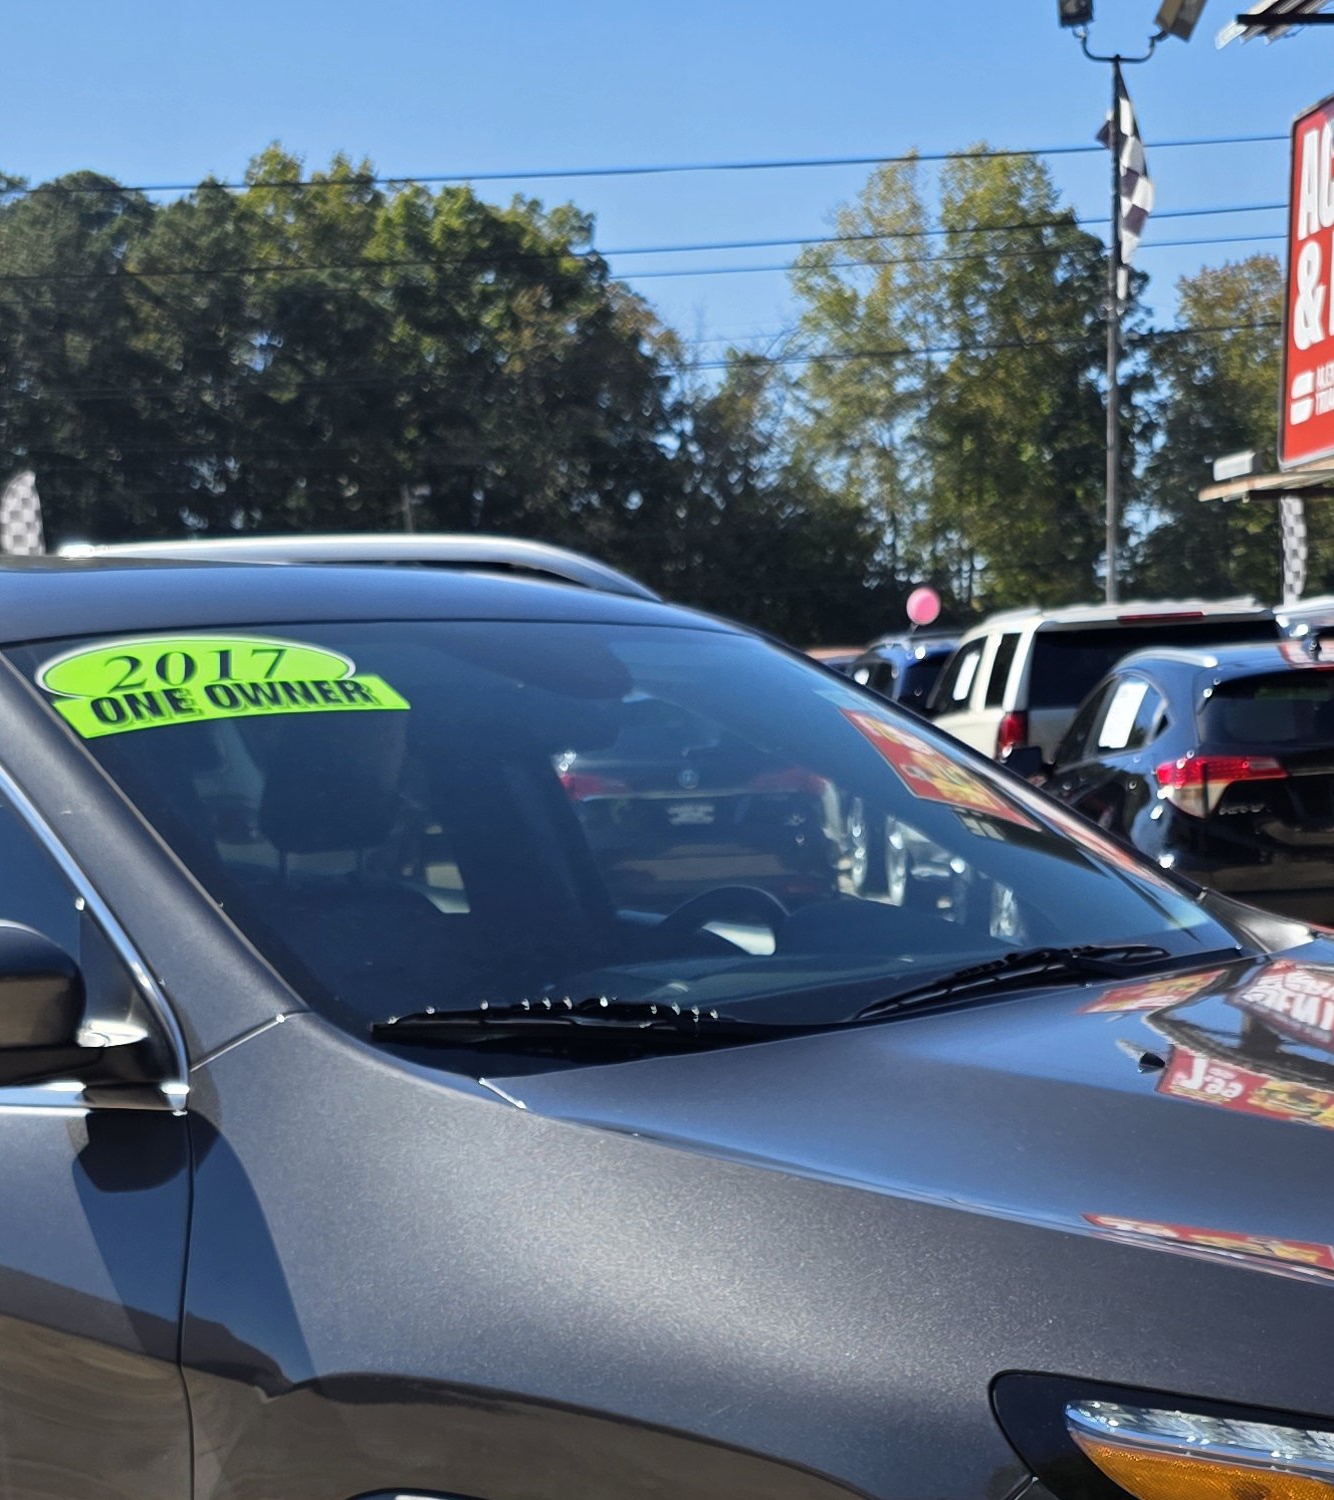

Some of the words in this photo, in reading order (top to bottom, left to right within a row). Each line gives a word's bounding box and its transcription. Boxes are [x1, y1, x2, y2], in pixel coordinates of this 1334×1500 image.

[1293, 240, 1325, 350] &
[105, 648, 287, 694] 2017
[90, 687, 196, 727] ONE
[204, 678, 376, 711] OWNER
